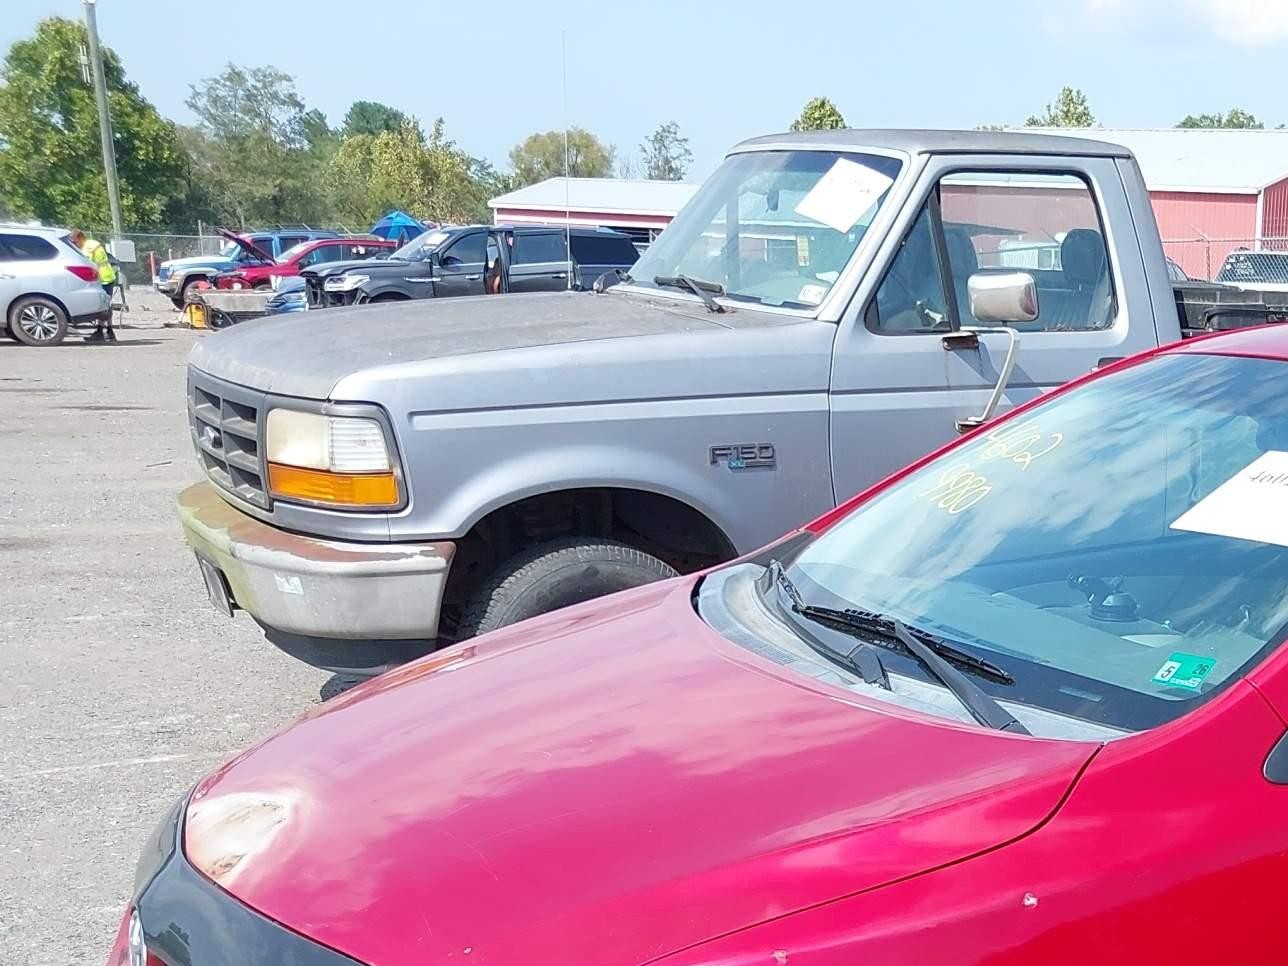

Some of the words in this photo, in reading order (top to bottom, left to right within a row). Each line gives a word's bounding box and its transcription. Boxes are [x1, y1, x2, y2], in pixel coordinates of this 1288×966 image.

[708, 443, 776, 466] F150
[919, 462, 992, 514] 9980
[1160, 665, 1176, 679] 5
[1191, 663, 1210, 676] 26
